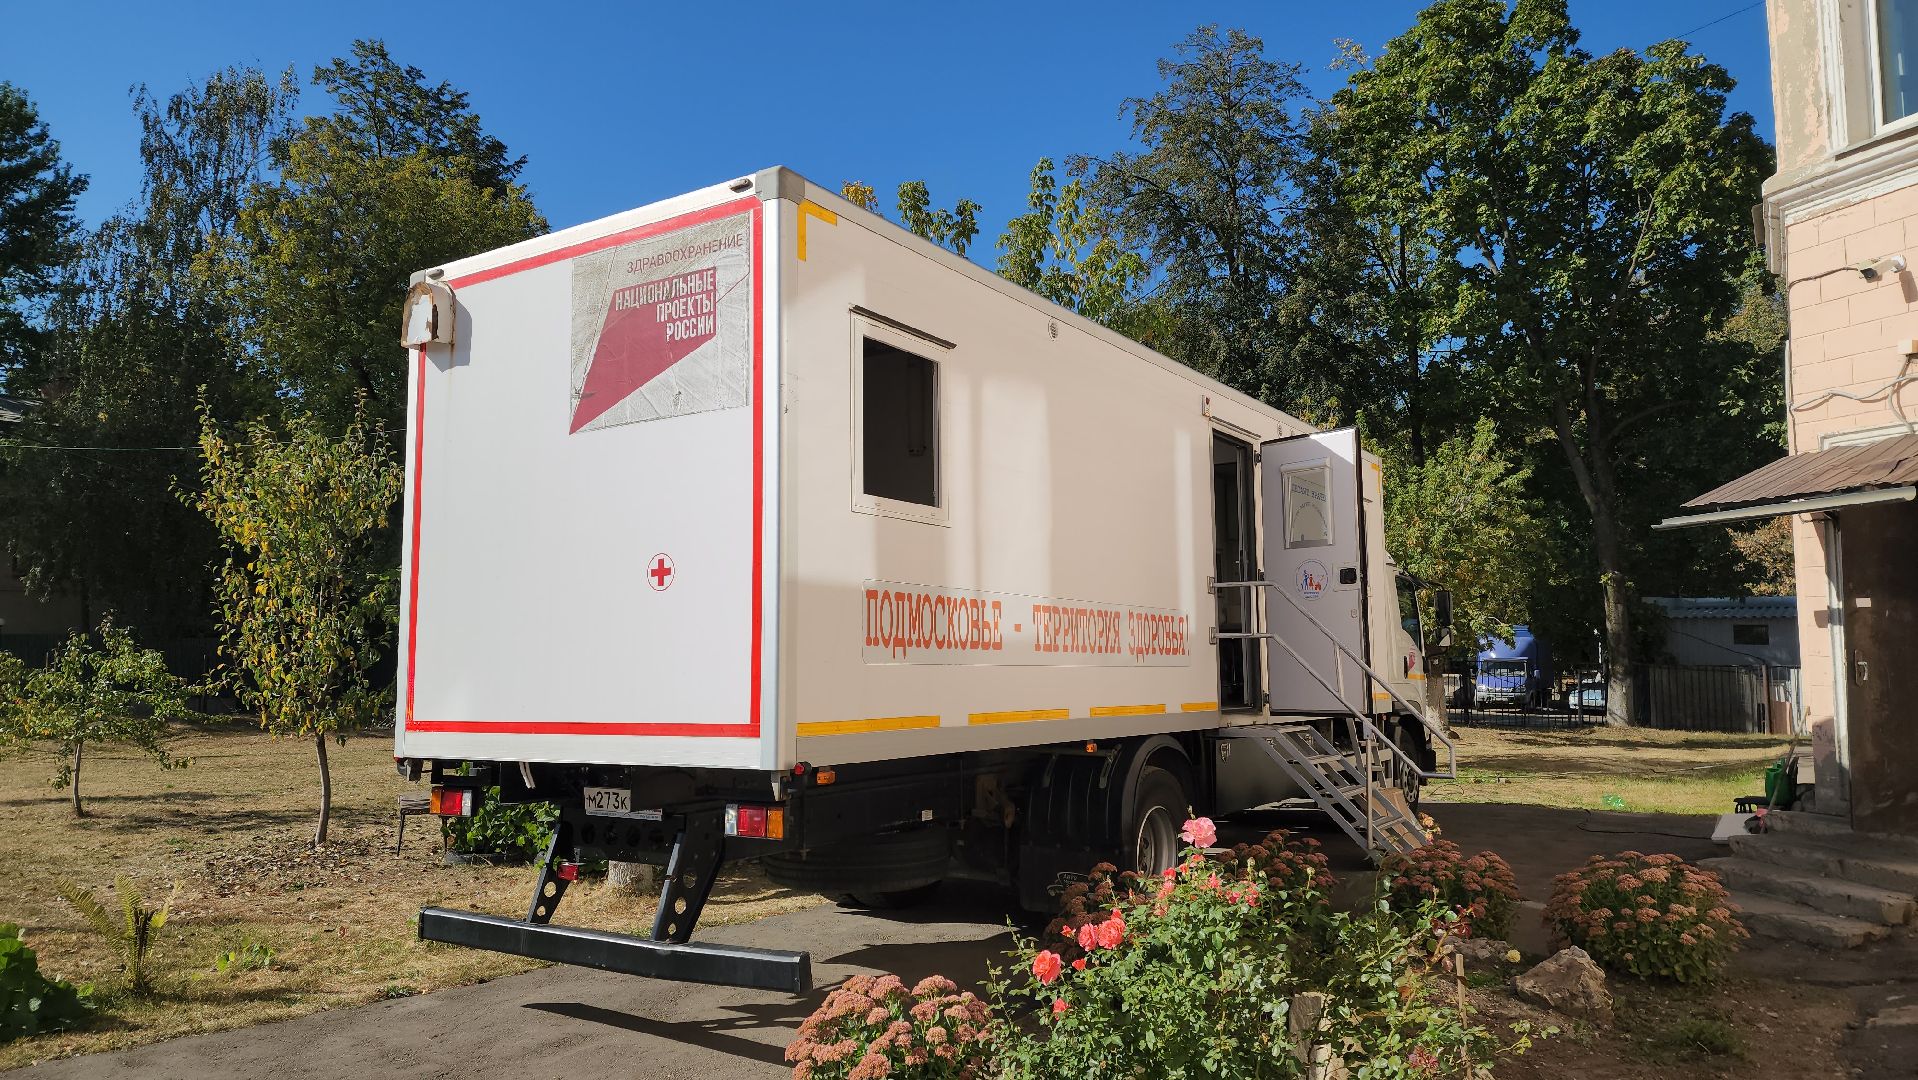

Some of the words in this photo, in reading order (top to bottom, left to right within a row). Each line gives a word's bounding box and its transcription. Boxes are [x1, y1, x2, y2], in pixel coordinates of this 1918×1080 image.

[627, 233, 744, 274] ЗДРАВООХРАНЕНИЕ
[615, 269, 715, 311] НАЦИОНАЛЬНЫЕ
[656, 292, 714, 323] ПРОЕКТЫ
[666, 314, 714, 341] РОССИИ
[866, 589, 1003, 659] ПОДМОСКОВЬЕ
[1032, 604, 1122, 654] ТЕРРИТОРИЯ
[1128, 608, 1190, 663] ЗДОРОВЬЯ!
